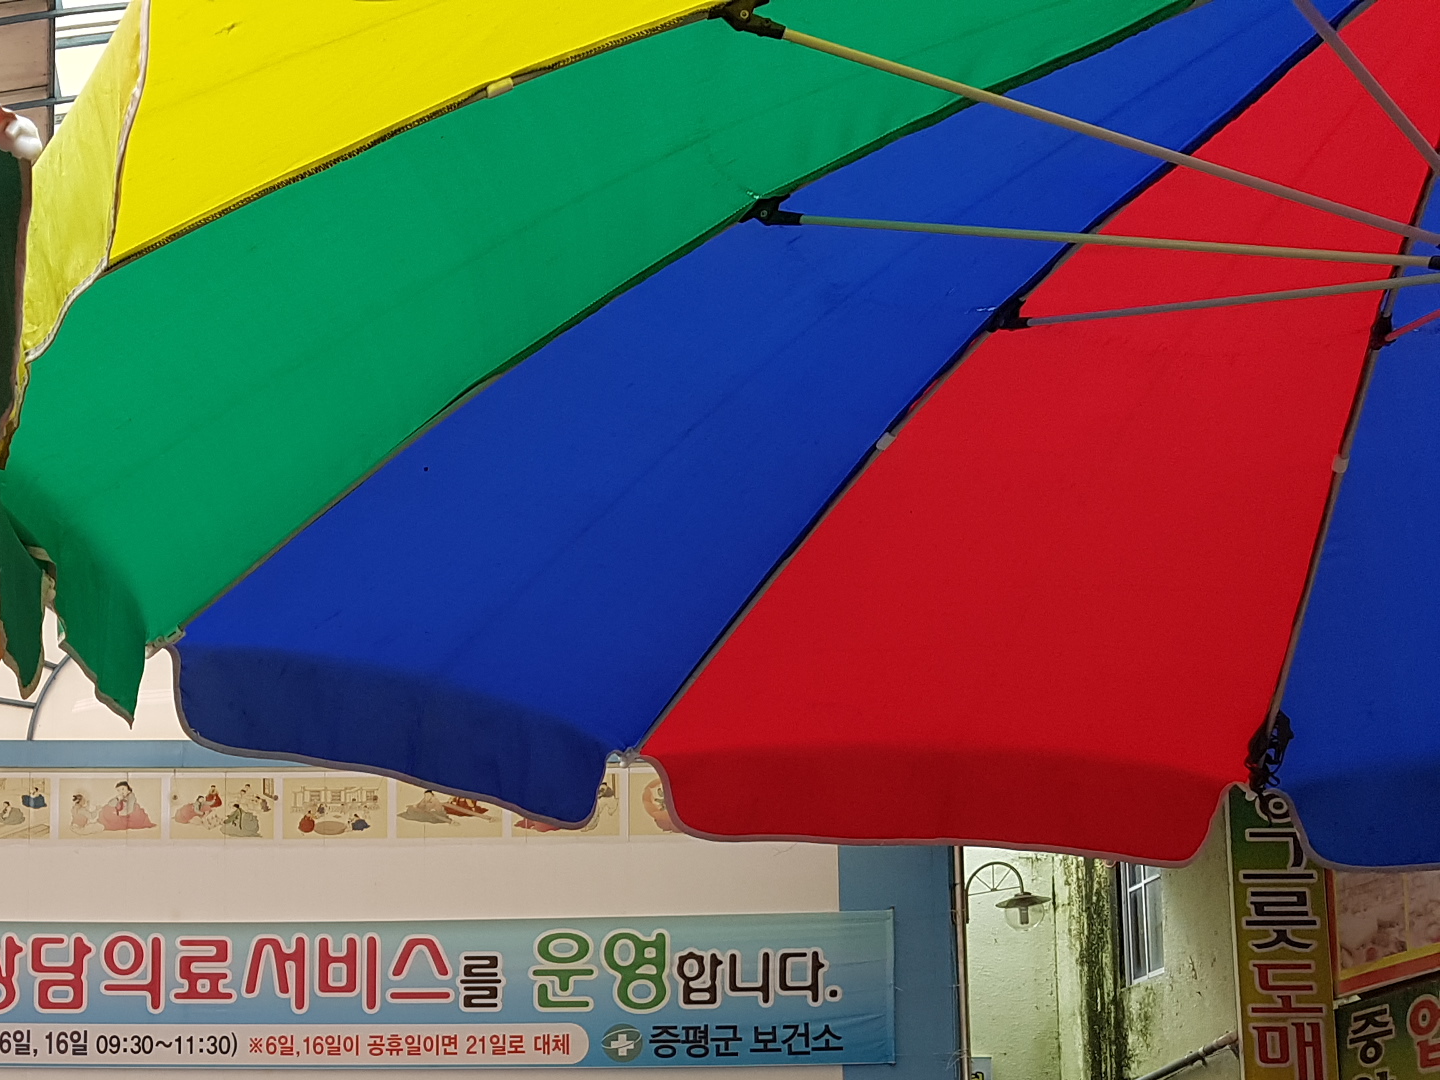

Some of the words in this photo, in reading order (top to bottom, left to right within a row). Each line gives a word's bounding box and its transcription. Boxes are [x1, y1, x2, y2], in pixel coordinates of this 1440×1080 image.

[529, 929, 842, 1013] 운영합니다.
[44, 1031, 89, 1055] 16일
[96, 1032, 239, 1059] 09:30~11:30)
[367, 1033, 459, 1058] 공휴일이면
[466, 1034, 525, 1058] 21일로
[533, 1034, 570, 1057] 대체
[648, 1026, 742, 1058] 증평군
[749, 1023, 844, 1057] 보건소
